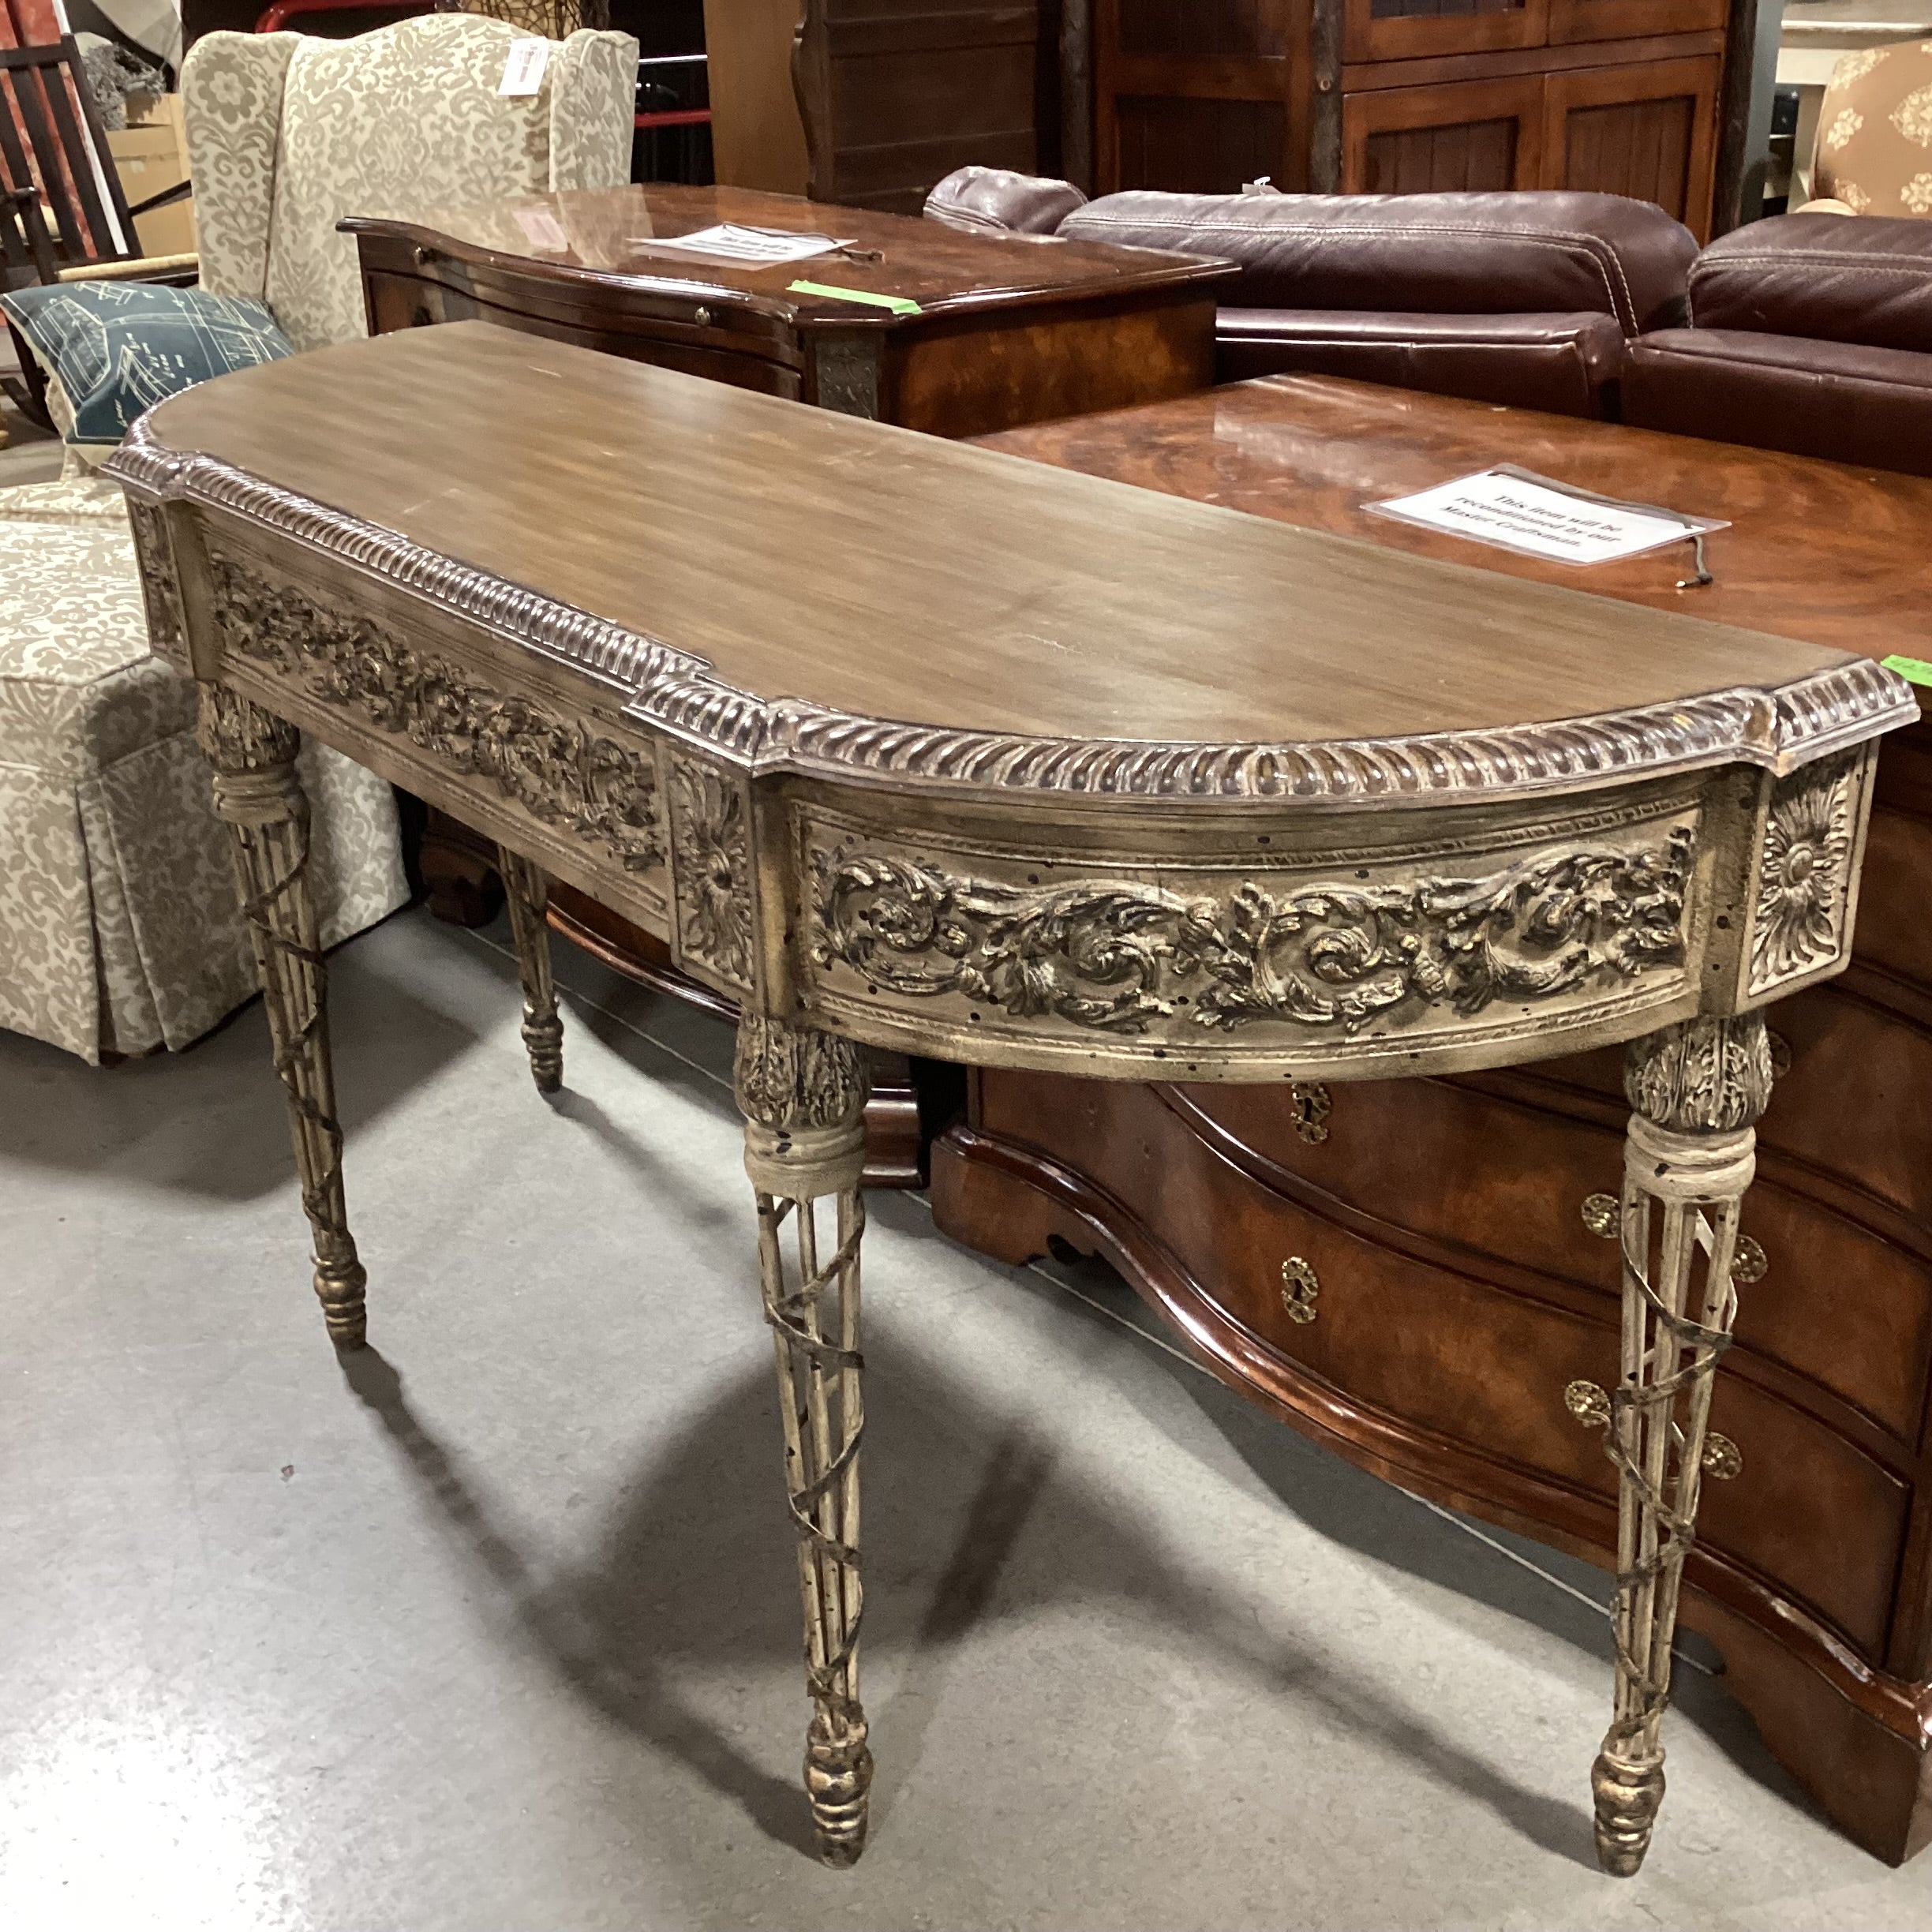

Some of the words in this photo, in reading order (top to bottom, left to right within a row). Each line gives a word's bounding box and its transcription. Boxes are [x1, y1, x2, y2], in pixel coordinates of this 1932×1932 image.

[1440, 505, 1496, 522] Master
[1455, 496, 1567, 530] reconditioned
[1587, 533, 1621, 542] our
[1494, 495, 1528, 509] This
[1529, 507, 1567, 519] item
[1567, 517, 1601, 527] will
[1601, 523, 1623, 532] be
